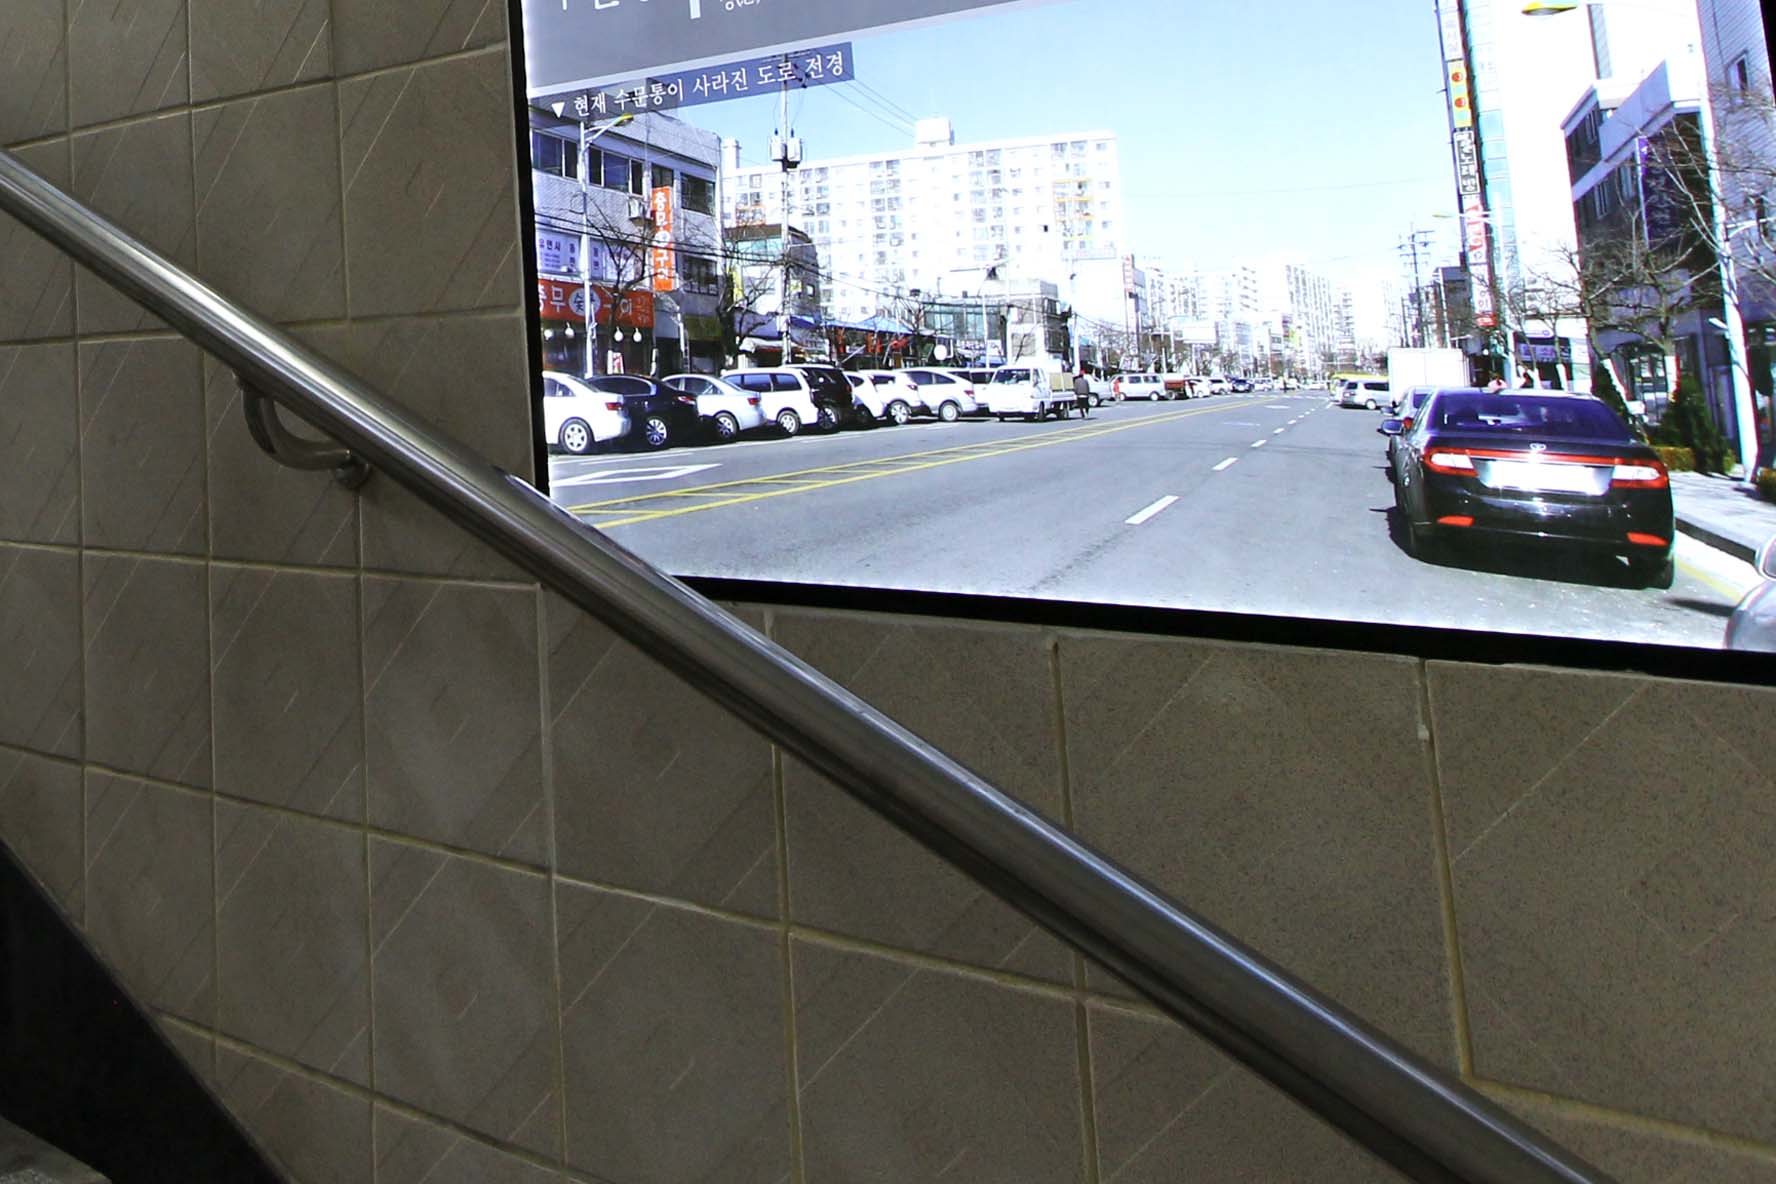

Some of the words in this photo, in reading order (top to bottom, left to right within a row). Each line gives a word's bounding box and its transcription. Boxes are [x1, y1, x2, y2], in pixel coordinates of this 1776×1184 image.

[574, 92, 607, 120] 현재
[616, 79, 686, 114] 수문통이
[692, 64, 750, 99] 사라진
[757, 59, 796, 86] 도로
[807, 50, 846, 81] 전경
